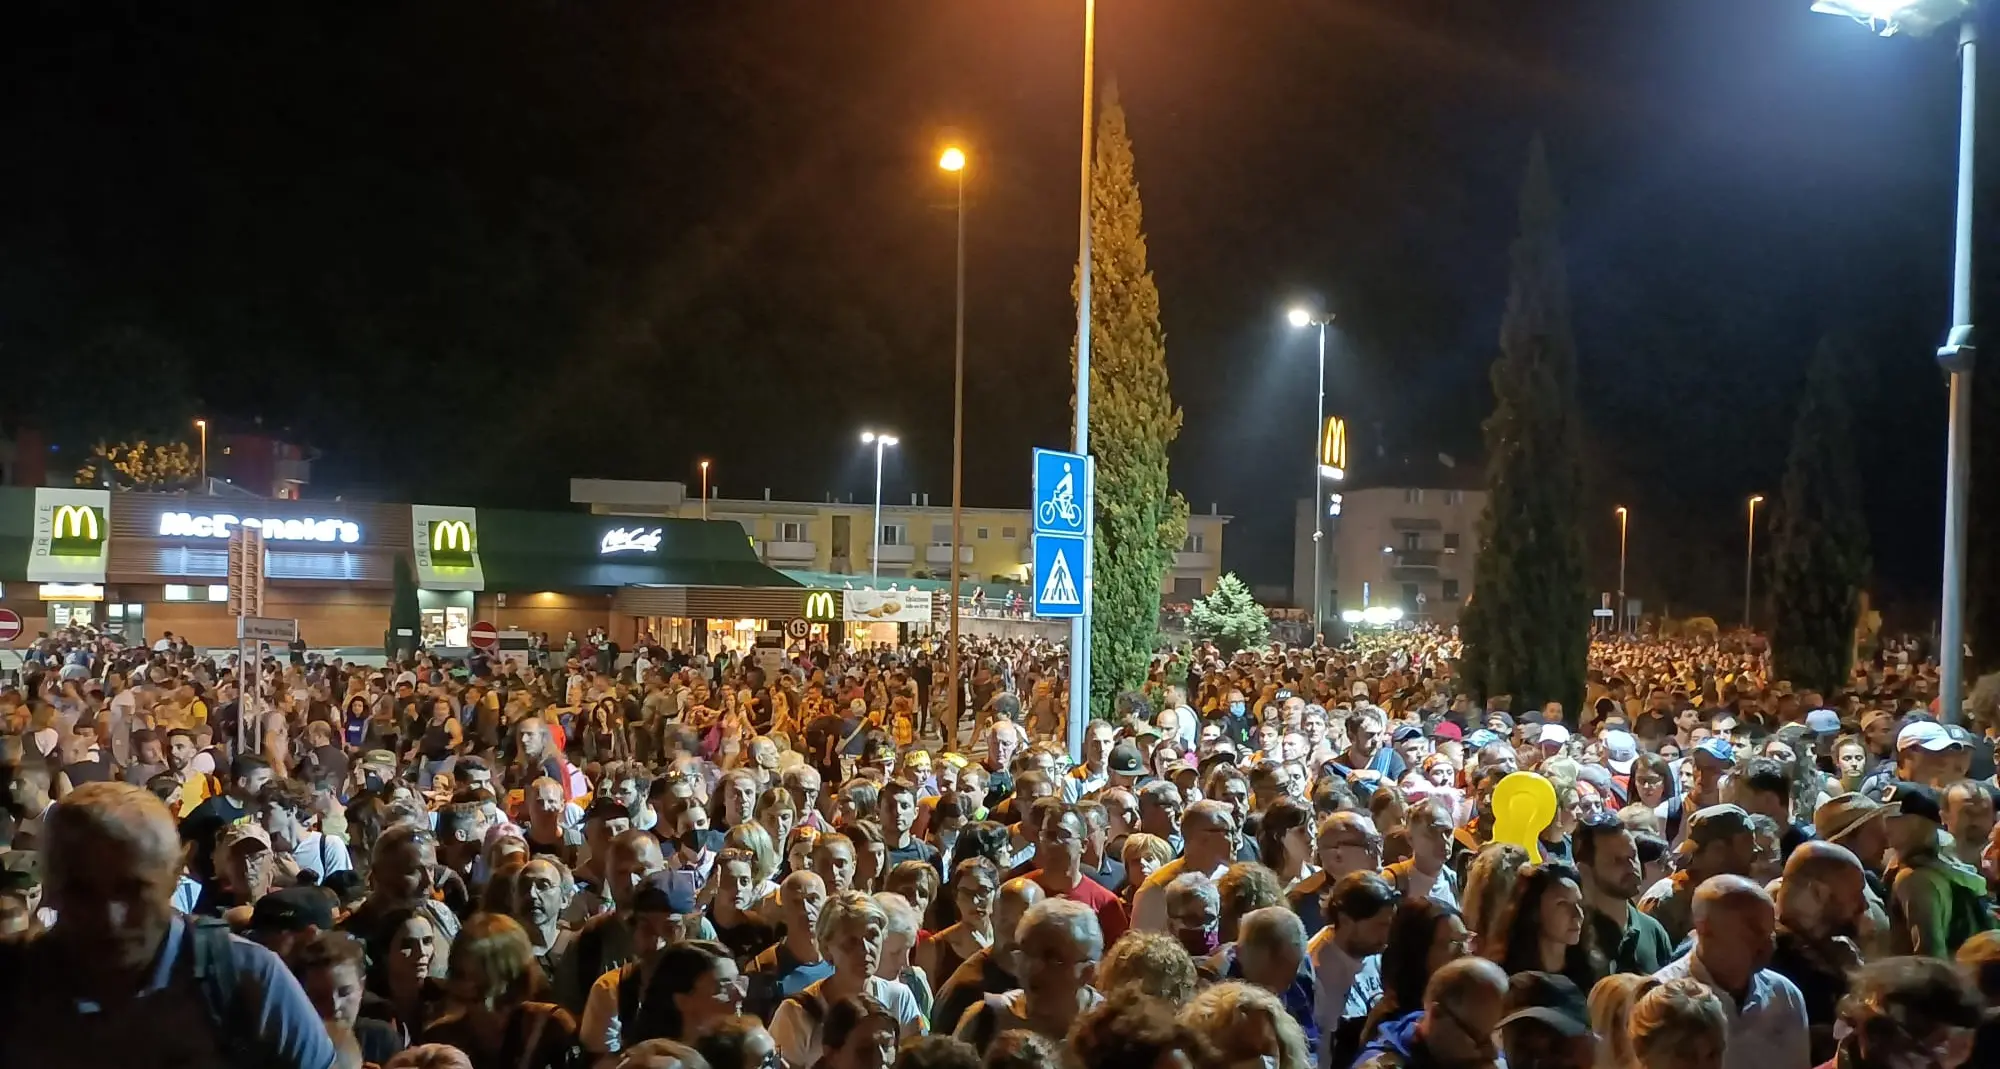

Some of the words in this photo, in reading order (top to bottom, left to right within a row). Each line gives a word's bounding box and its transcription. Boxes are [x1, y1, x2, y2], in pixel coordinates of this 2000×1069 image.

[36, 504, 51, 556] DRIVE
[416, 520, 428, 566] DRIVE
[793, 622, 806, 635] 15
